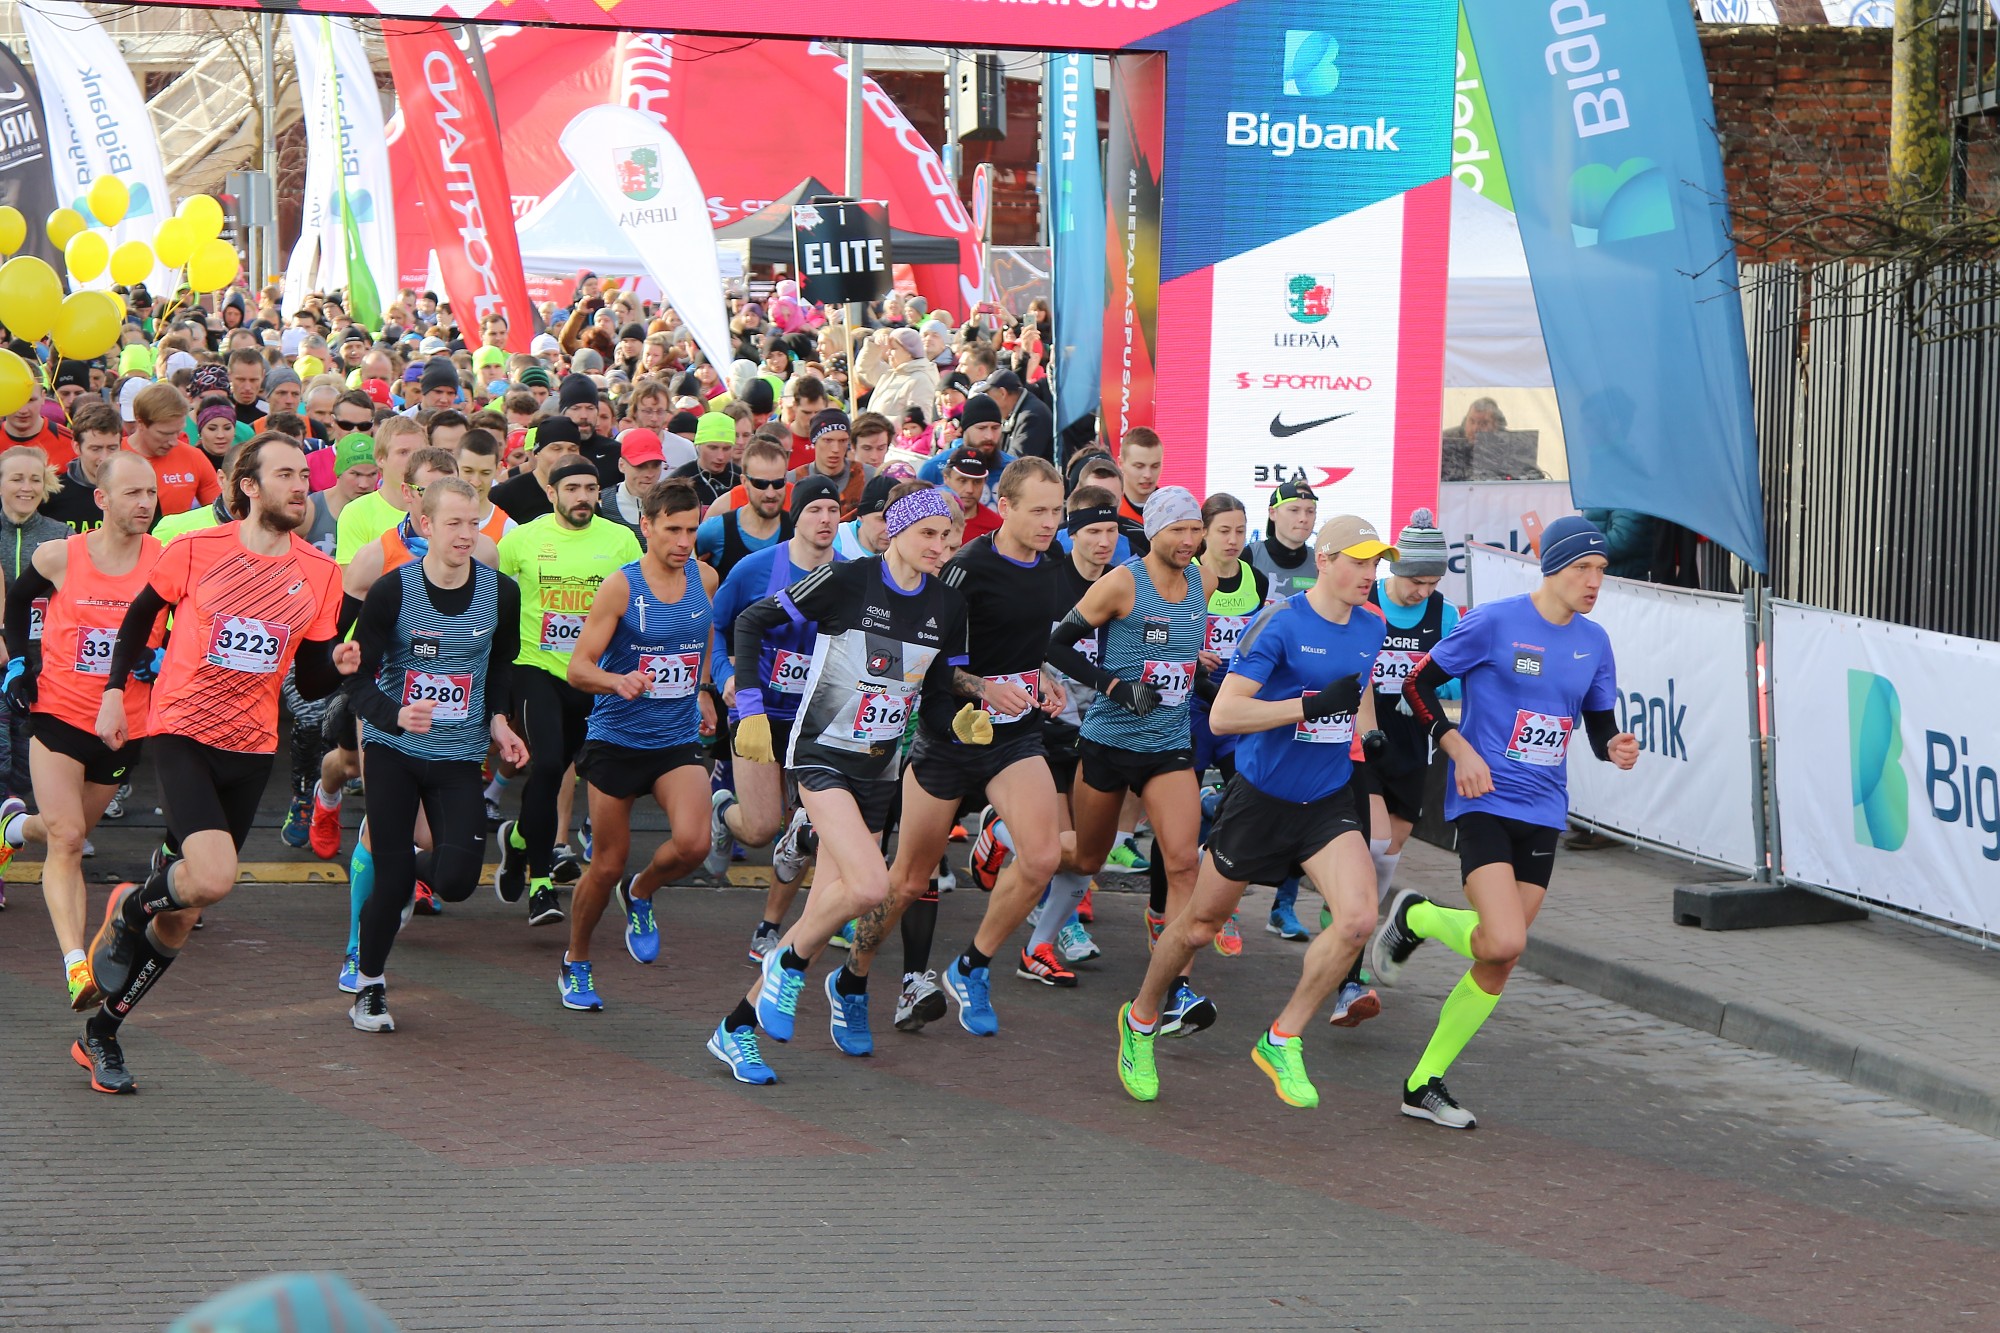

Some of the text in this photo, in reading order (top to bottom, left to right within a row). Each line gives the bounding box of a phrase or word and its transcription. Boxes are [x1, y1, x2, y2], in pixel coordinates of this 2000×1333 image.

[1226, 111, 1400, 157] Bigbank
[804, 238, 885, 275] ELITE
[1274, 331, 1340, 350] LIEPĀJA
[1262, 373, 1373, 391] SPORTLAND
[162, 472, 183, 484] tet
[217, 629, 279, 656] 3223
[410, 683, 465, 703] 3280
[1149, 674, 1190, 691] 3218
[1518, 726, 1568, 748] 3247
[1925, 729, 2000, 861] Big
